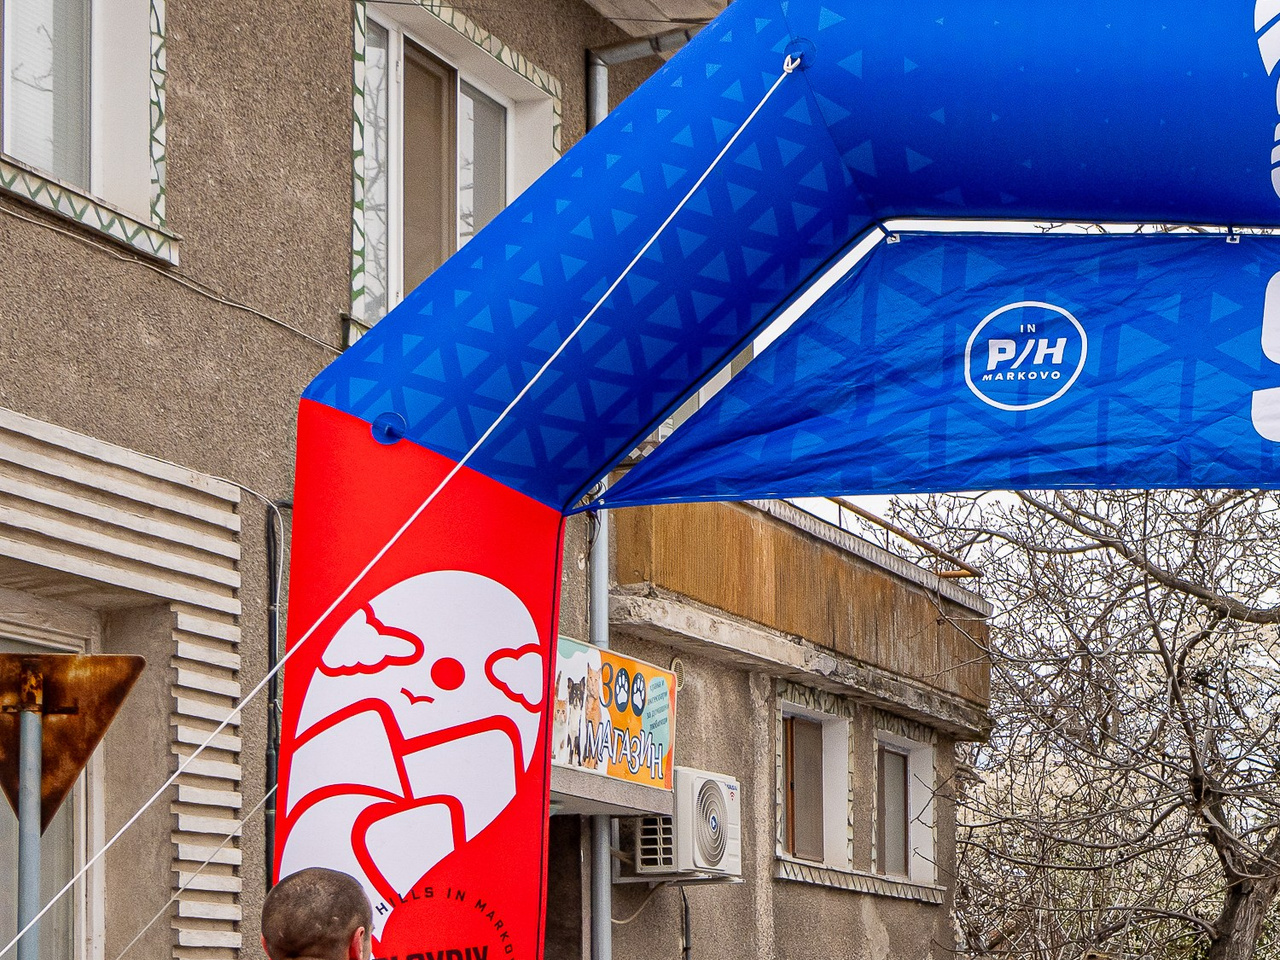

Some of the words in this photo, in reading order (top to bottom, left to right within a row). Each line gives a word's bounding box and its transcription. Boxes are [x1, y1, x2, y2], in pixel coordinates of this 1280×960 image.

[1020, 324, 1036, 333] IN
[986, 337, 1067, 371] P/H
[982, 371, 1061, 381] MARKOVO
[585, 719, 664, 779] МАГАЗИН
[375, 887, 434, 916] HILLS
[447, 888, 466, 902] IN
